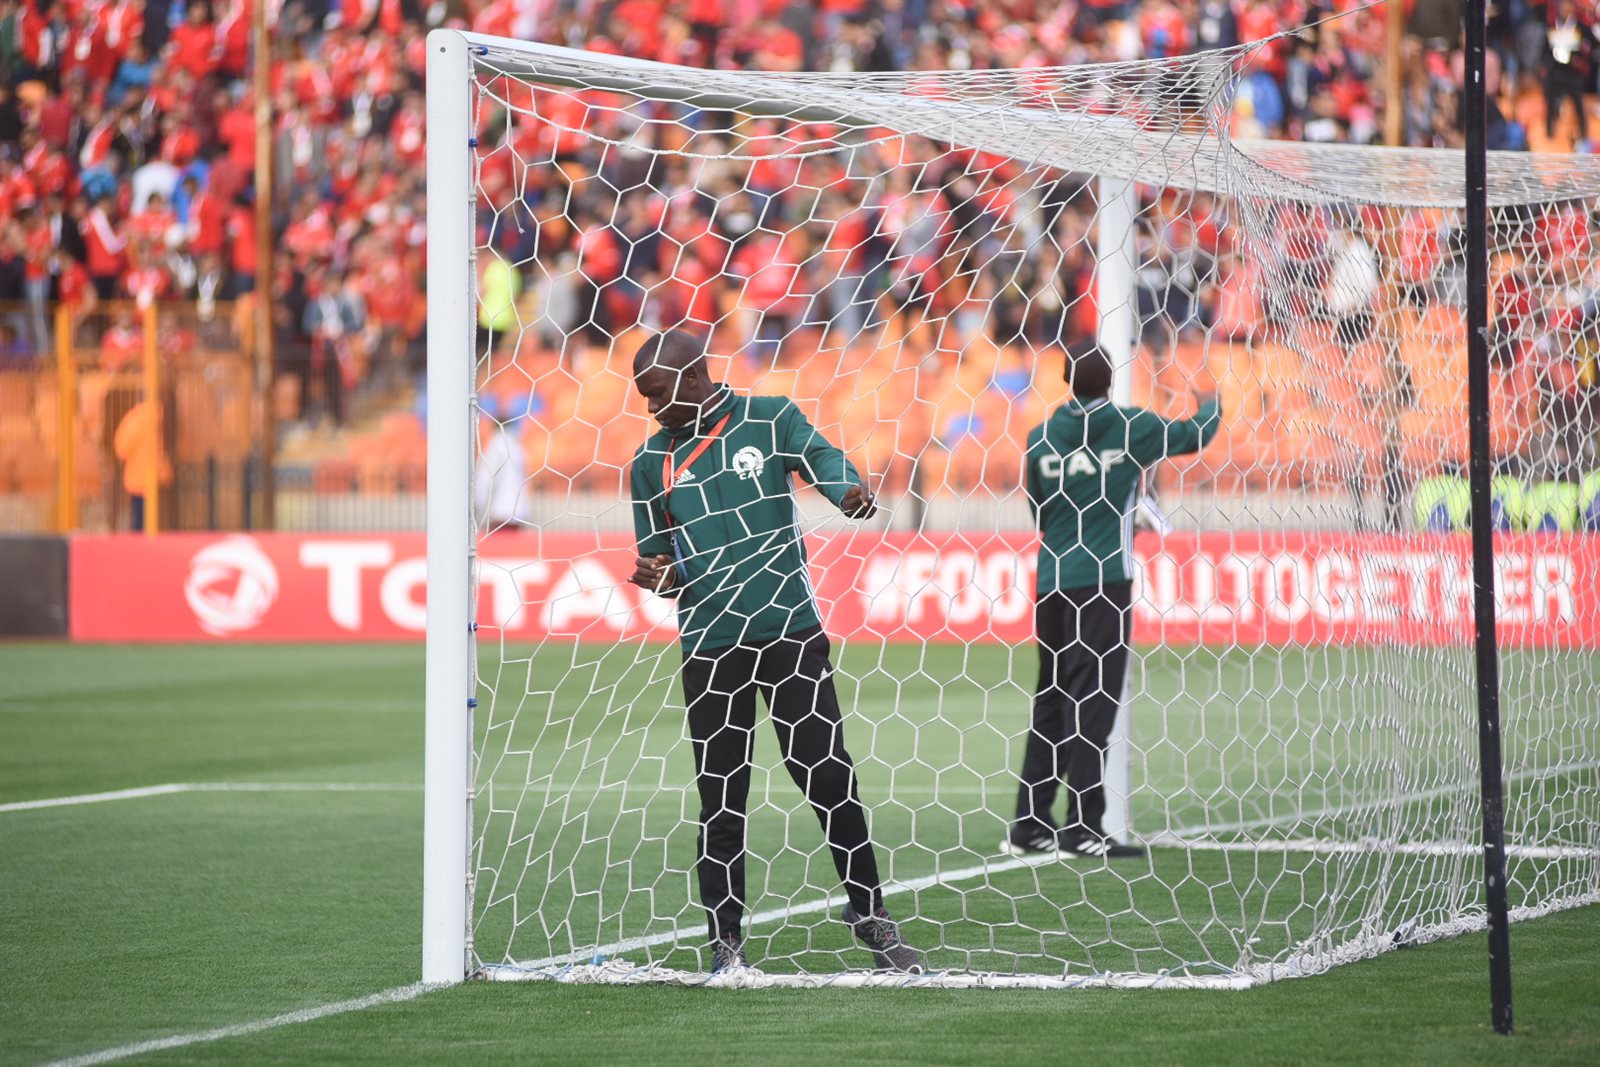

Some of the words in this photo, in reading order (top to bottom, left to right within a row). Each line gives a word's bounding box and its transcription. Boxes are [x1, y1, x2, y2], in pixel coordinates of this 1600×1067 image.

[739, 469, 764, 480] CAF
[1039, 448, 1125, 478] CAF
[864, 552, 1576, 626] #FOOLLTOGETHER
